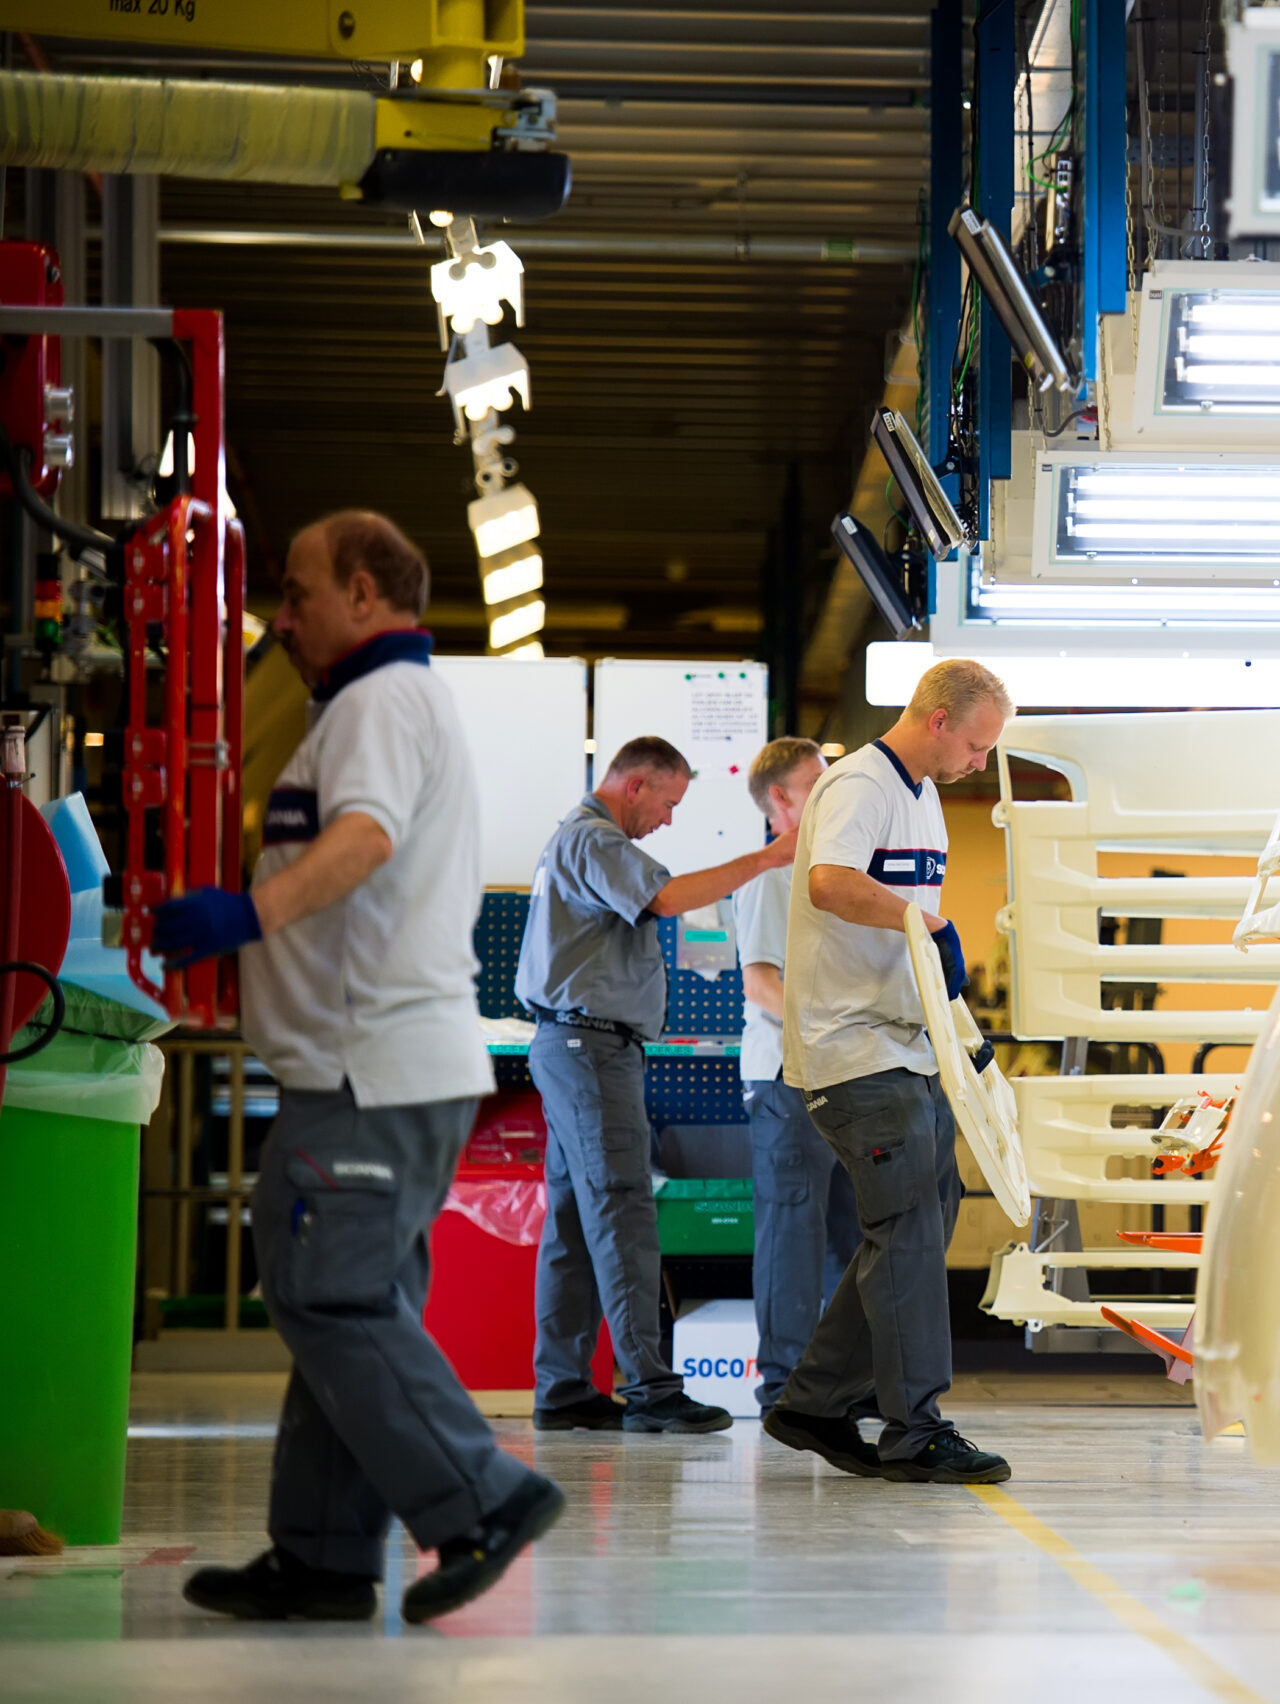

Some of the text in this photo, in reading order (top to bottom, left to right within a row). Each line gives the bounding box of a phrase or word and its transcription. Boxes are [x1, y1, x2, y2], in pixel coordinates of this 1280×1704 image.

[110, 0, 141, 13] max
[148, 0, 169, 15] 20
[556, 1011, 616, 1032] SCANIA
